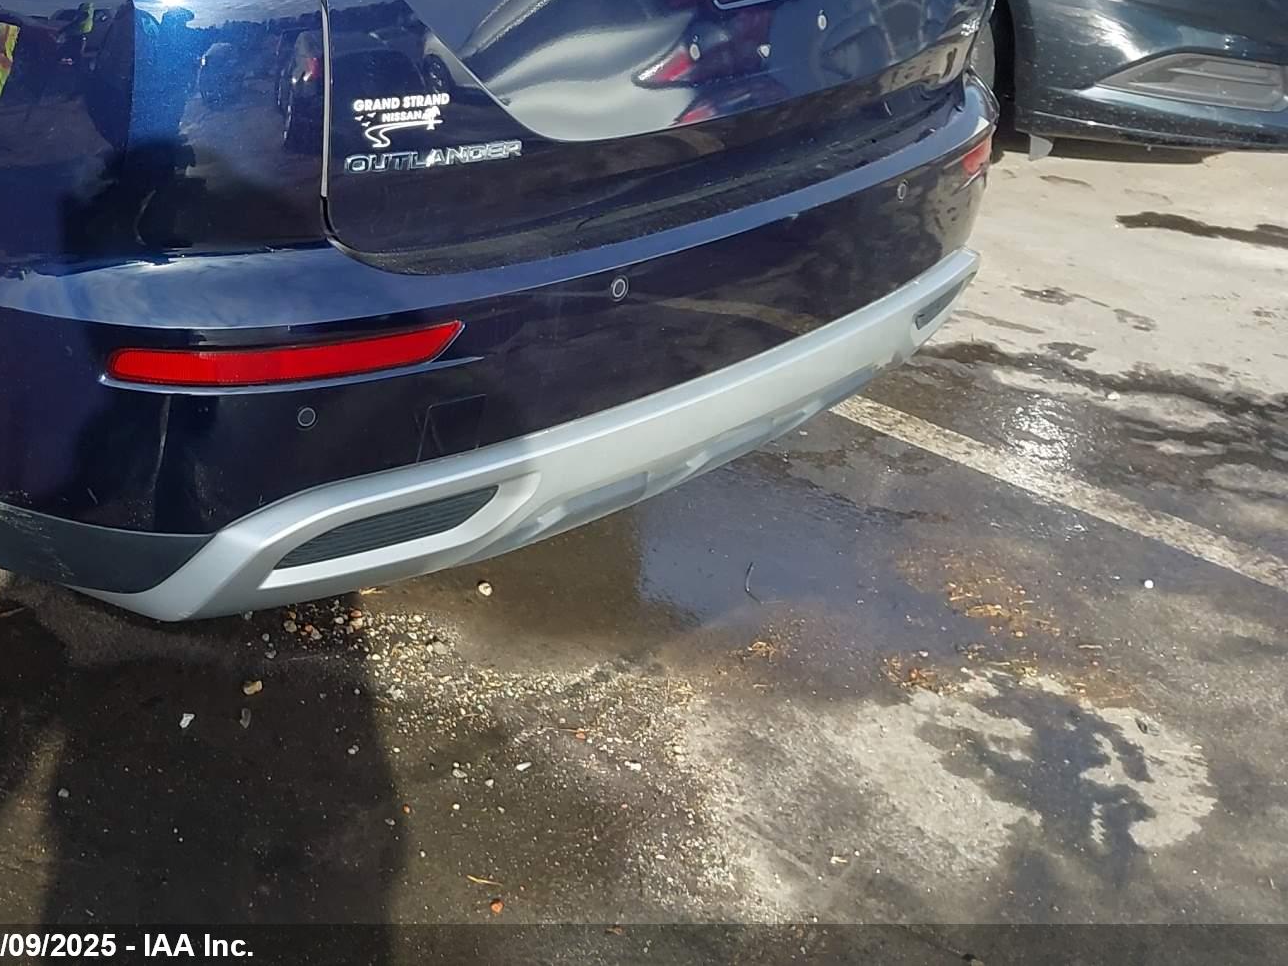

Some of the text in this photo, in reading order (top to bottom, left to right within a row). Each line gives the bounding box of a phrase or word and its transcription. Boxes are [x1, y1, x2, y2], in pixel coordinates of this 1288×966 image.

[353, 93, 450, 112] GRAND STRAND
[382, 110, 423, 122] NISSAN
[344, 140, 522, 173] OUTLANDER
